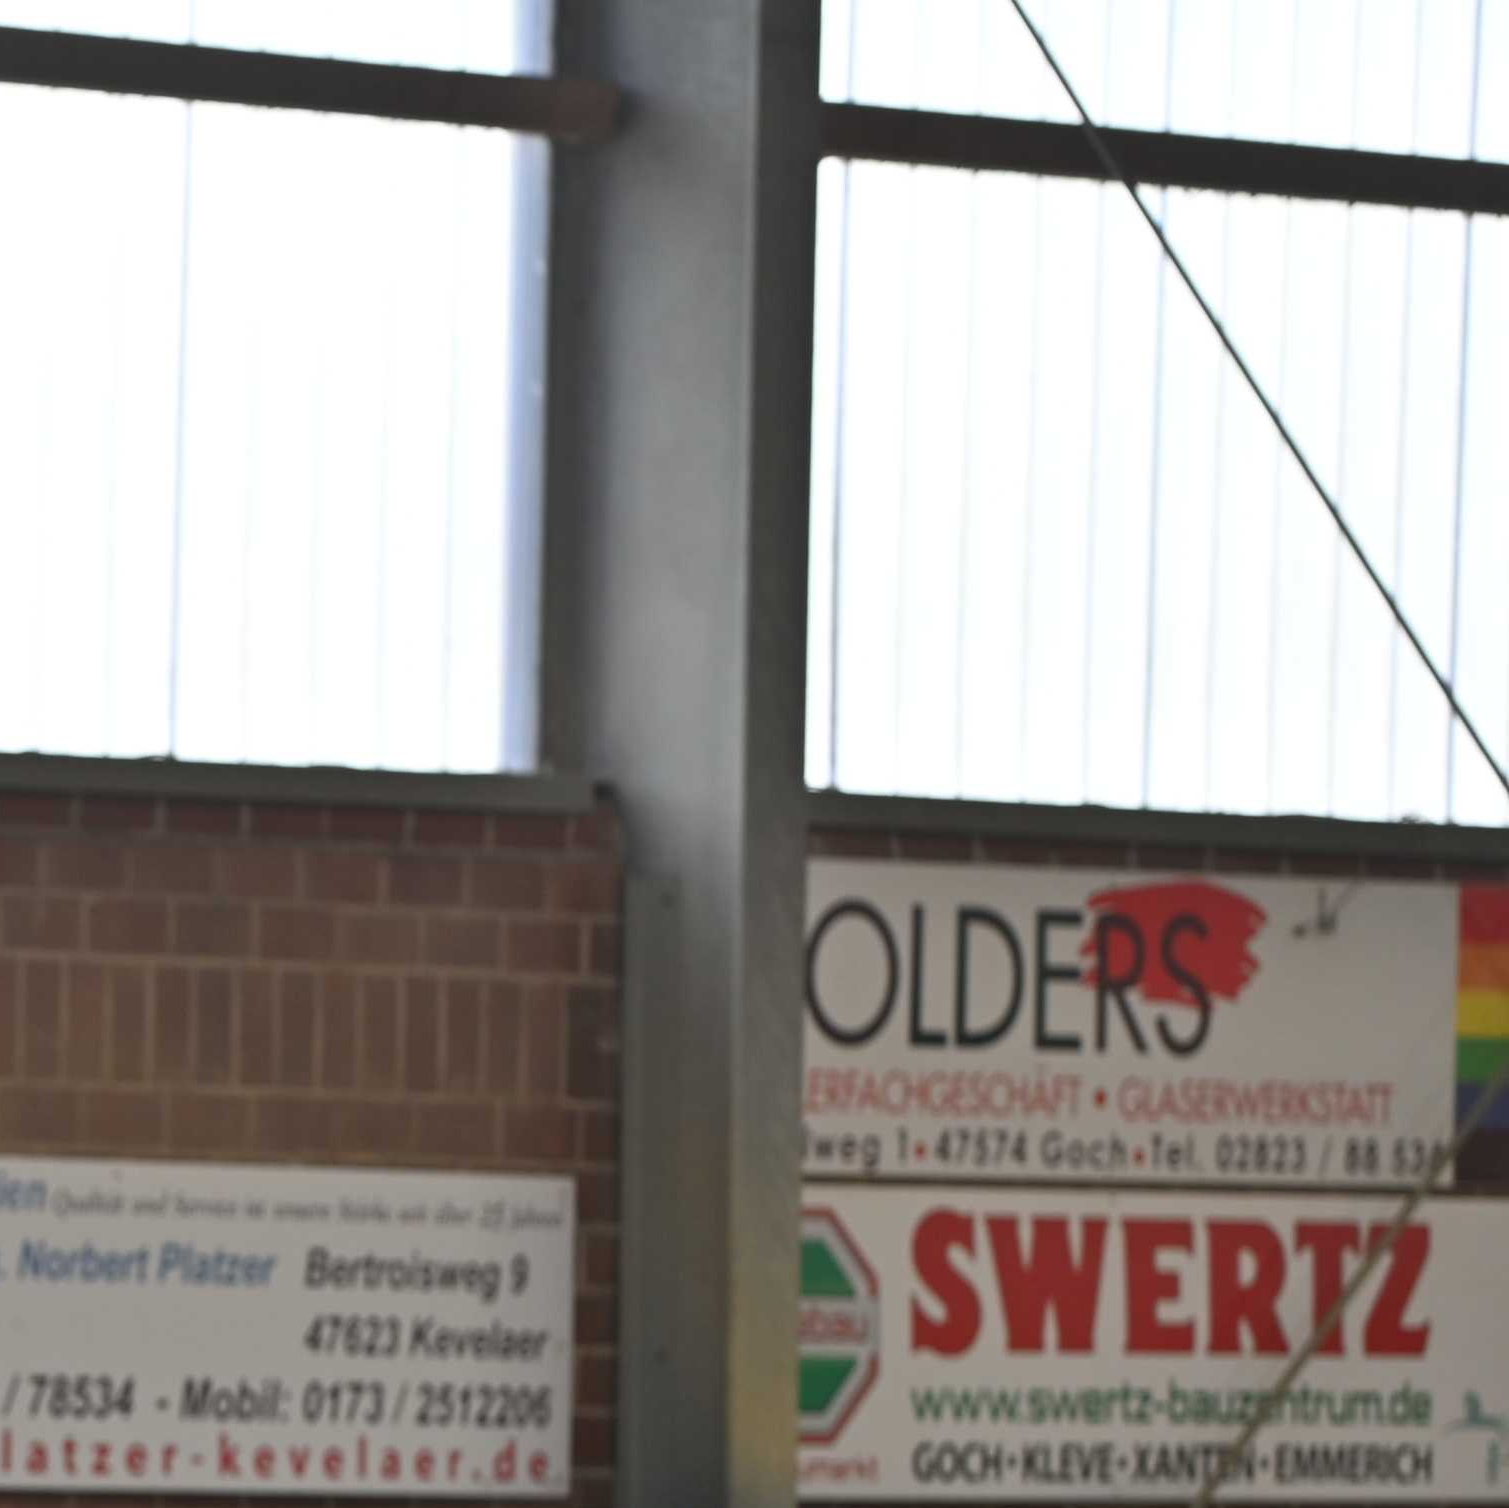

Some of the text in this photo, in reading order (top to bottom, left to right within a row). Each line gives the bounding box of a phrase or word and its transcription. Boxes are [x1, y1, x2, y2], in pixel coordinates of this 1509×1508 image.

[806, 899, 1213, 1058] OLDERS
[1041, 1128, 1128, 1171] Goch
[17, 1240, 149, 1287] Norbert
[155, 1242, 277, 1288] Platzer
[909, 1205, 1431, 1360] SWERTZ
[303, 1313, 550, 1364] 47623 Kevelaer
[28, 1372, 137, 1421] 78534
[301, 1378, 386, 1424] 0173
